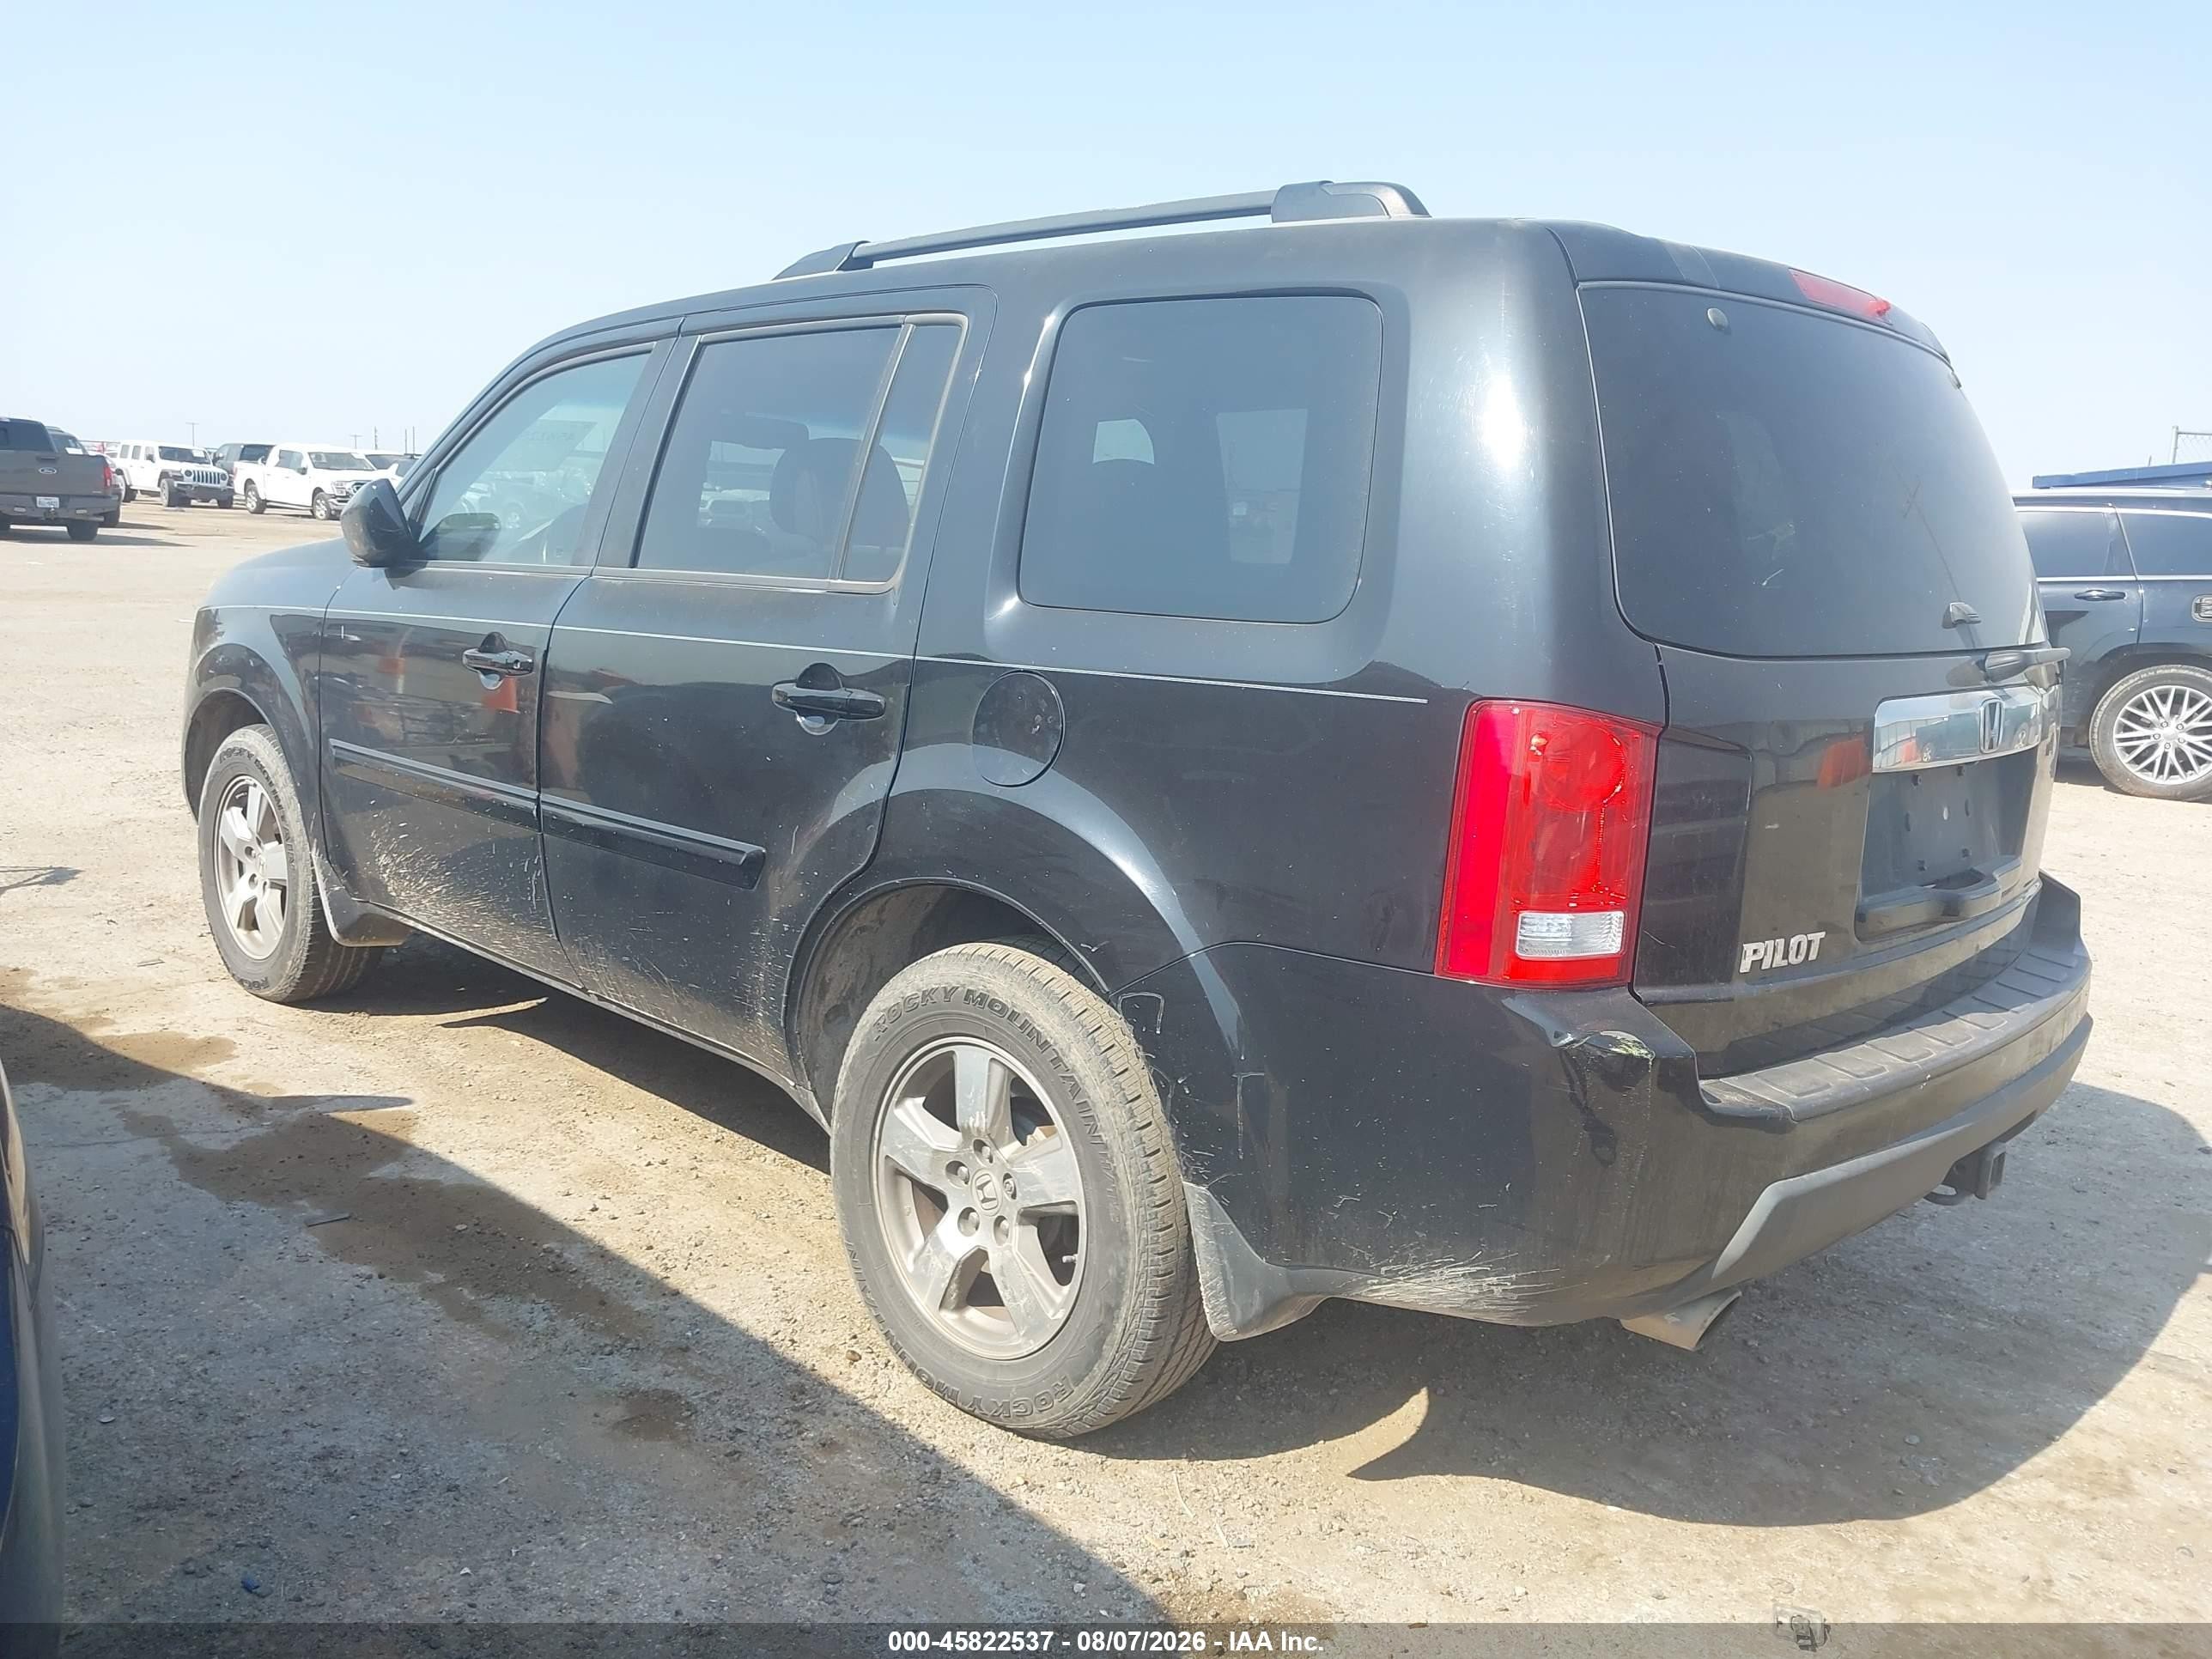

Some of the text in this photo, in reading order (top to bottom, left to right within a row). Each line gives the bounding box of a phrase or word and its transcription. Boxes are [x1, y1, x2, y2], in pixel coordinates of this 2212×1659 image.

[1739, 931, 1826, 974] PILOT
[872, 986, 1106, 1146] ROCKY MOUNTAIN
[966, 1375, 1074, 1419] ROCKY
